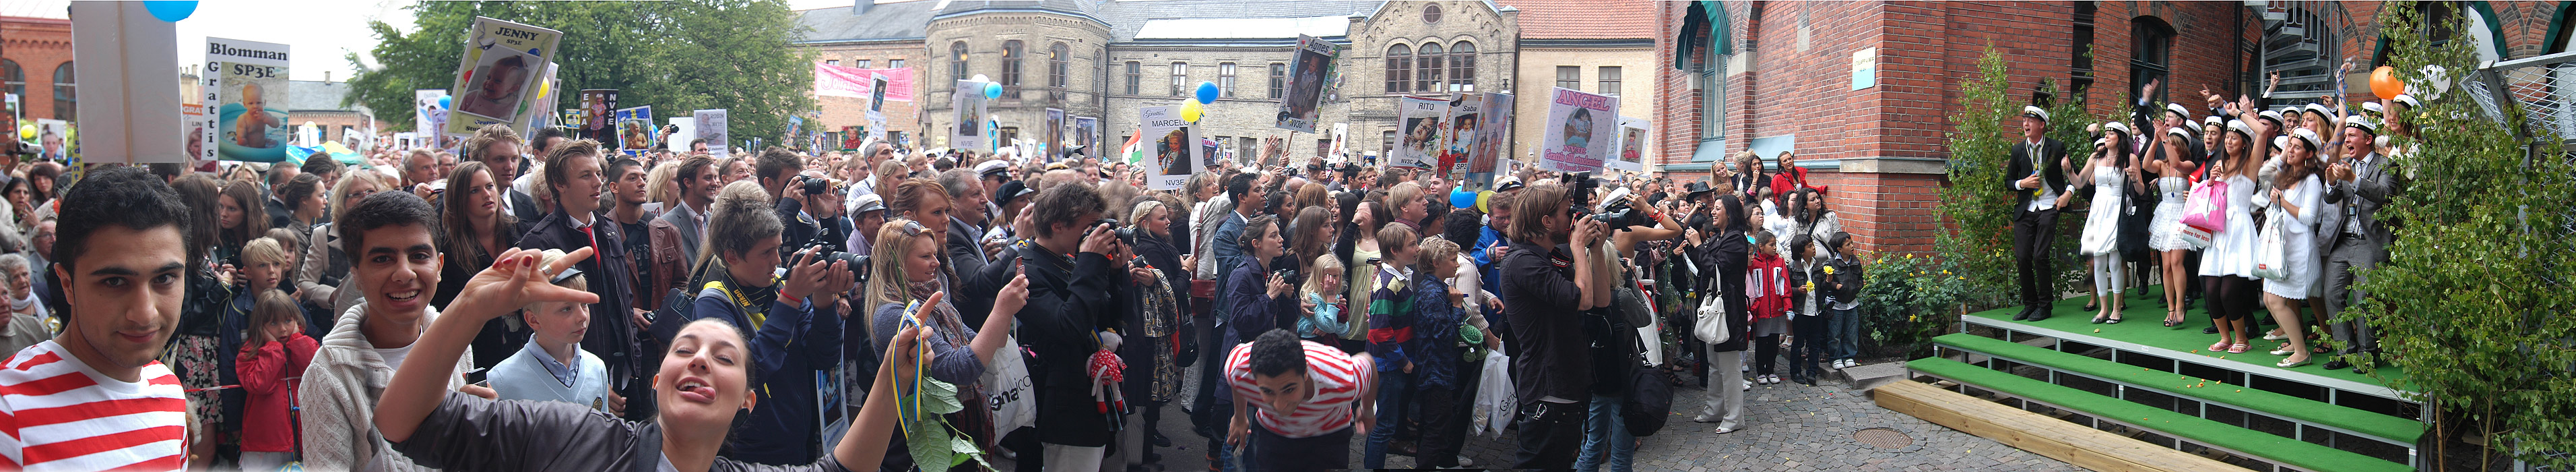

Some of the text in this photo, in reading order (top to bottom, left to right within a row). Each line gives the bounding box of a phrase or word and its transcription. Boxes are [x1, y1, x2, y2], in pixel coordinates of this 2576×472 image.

[495, 27, 539, 41] JENNY
[210, 42, 288, 61] Blomman
[1308, 39, 1330, 53] Agnes
[233, 64, 275, 78] SP3E
[1418, 102, 1434, 111] RITO
[1556, 90, 1610, 111] ANGEL
[207, 62, 218, 157] Grattis
[581, 93, 589, 125] EMMA
[608, 94, 616, 125] NV3E
[1152, 119, 1190, 127] MARCELO
[1201, 139, 1216, 147] EMMA
[1563, 145, 1587, 154] NV3E
[1545, 149, 1603, 168] Grattis till studenten
[734, 289, 750, 307] Nikon
